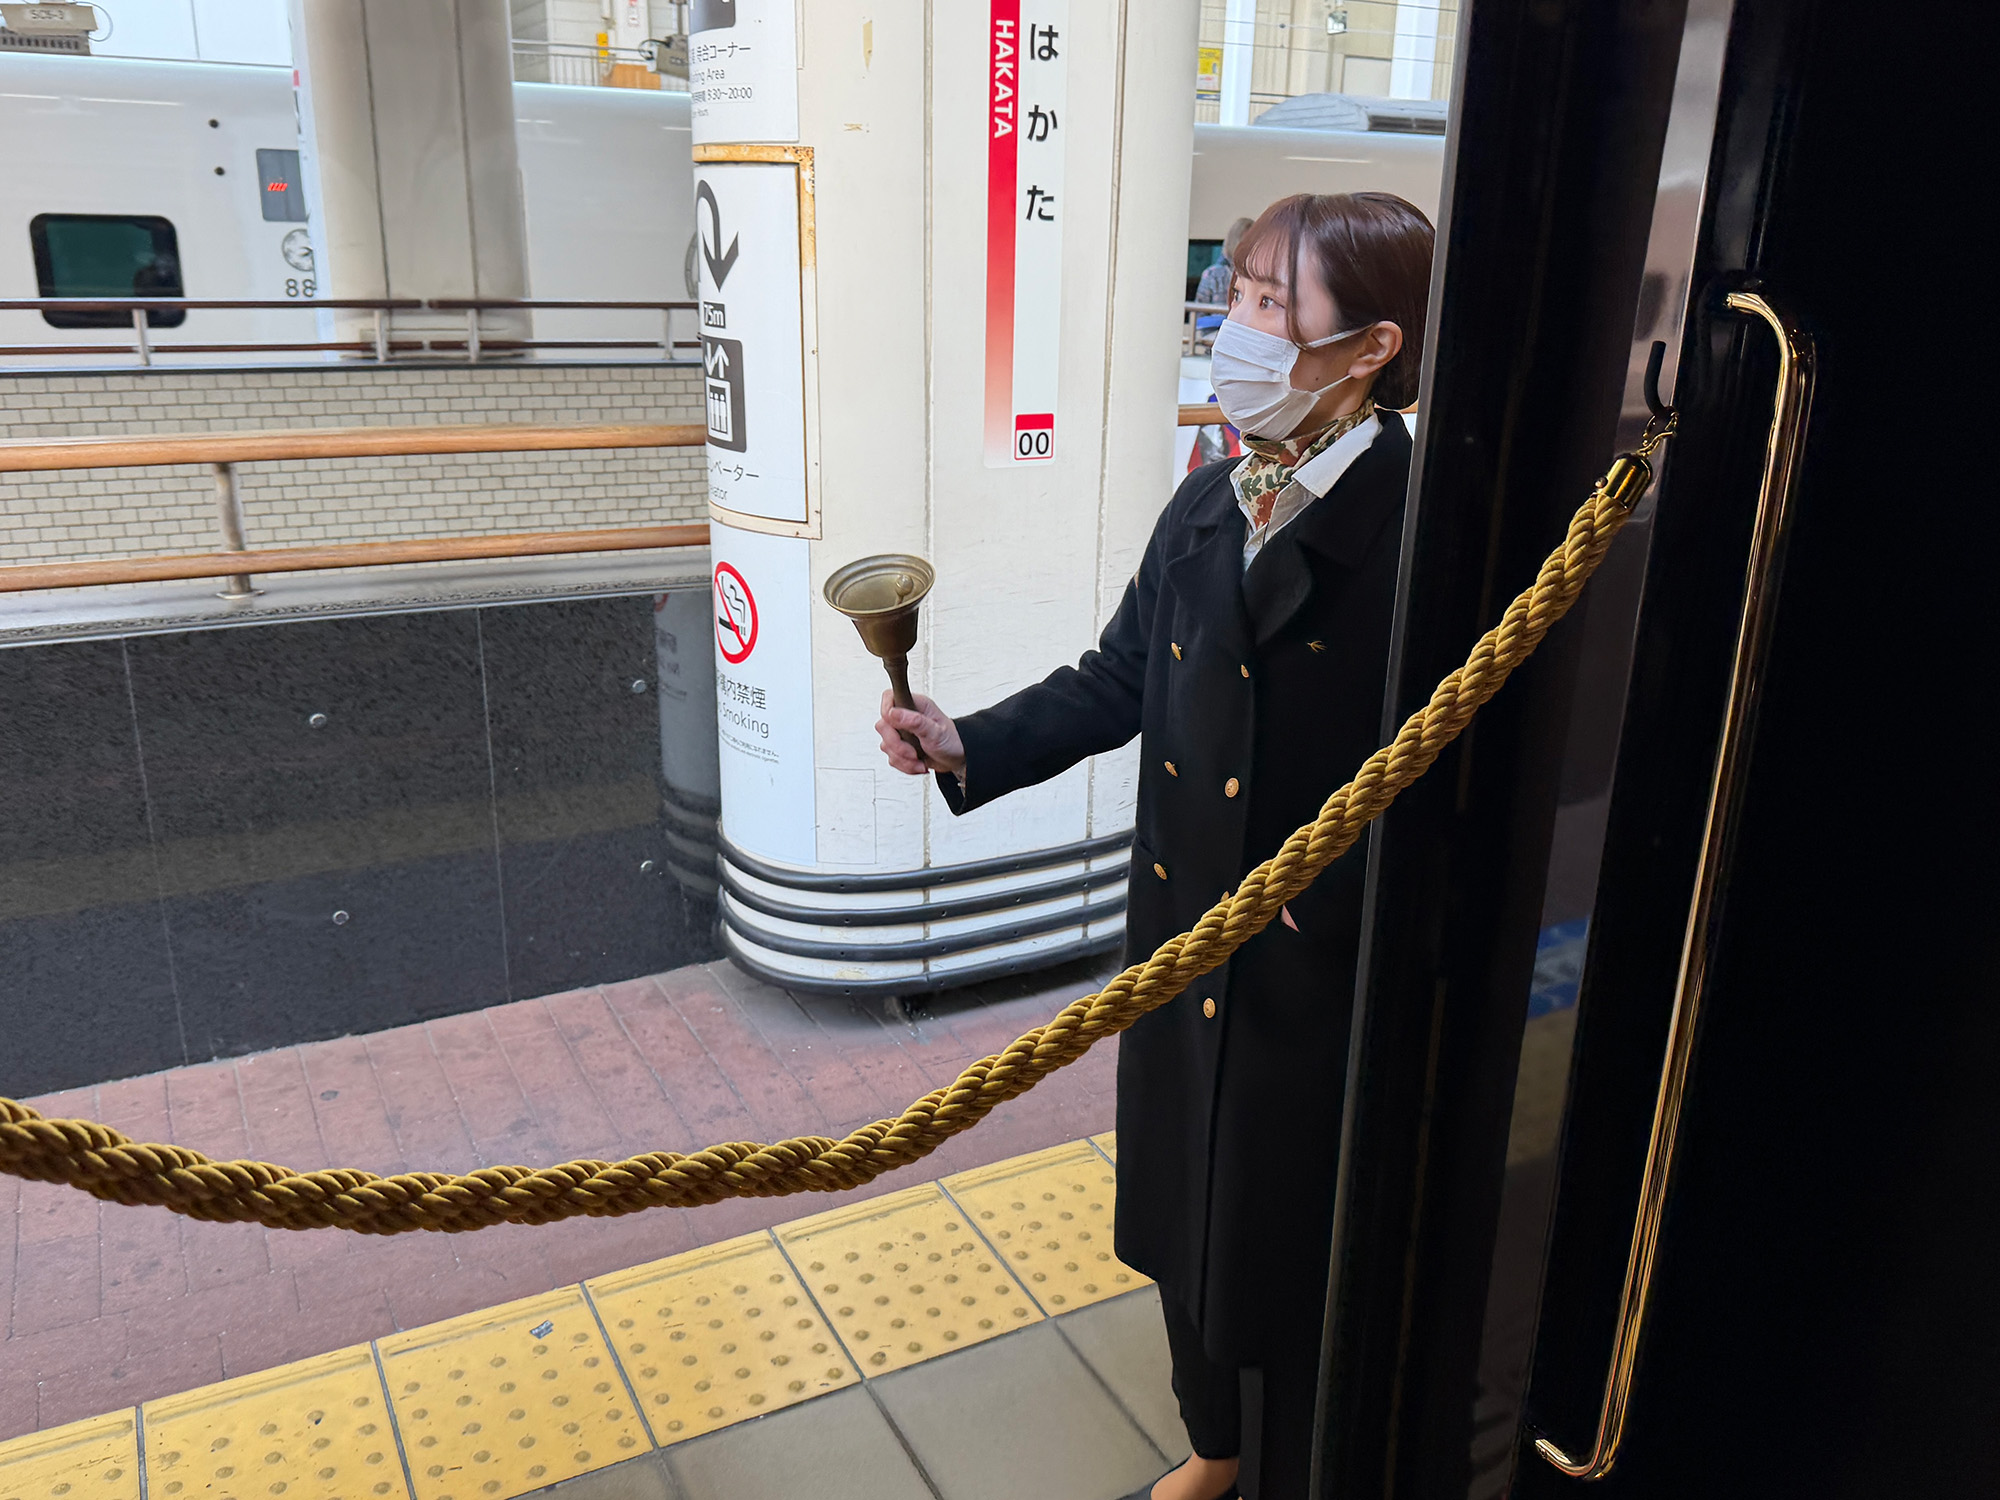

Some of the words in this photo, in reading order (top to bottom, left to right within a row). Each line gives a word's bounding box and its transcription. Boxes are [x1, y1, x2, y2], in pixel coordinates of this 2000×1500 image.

[707, 68, 725, 80] Area
[994, 19, 1015, 138] HAKATA
[1026, 23, 1059, 221] はかた
[1019, 431, 1050, 456] 00
